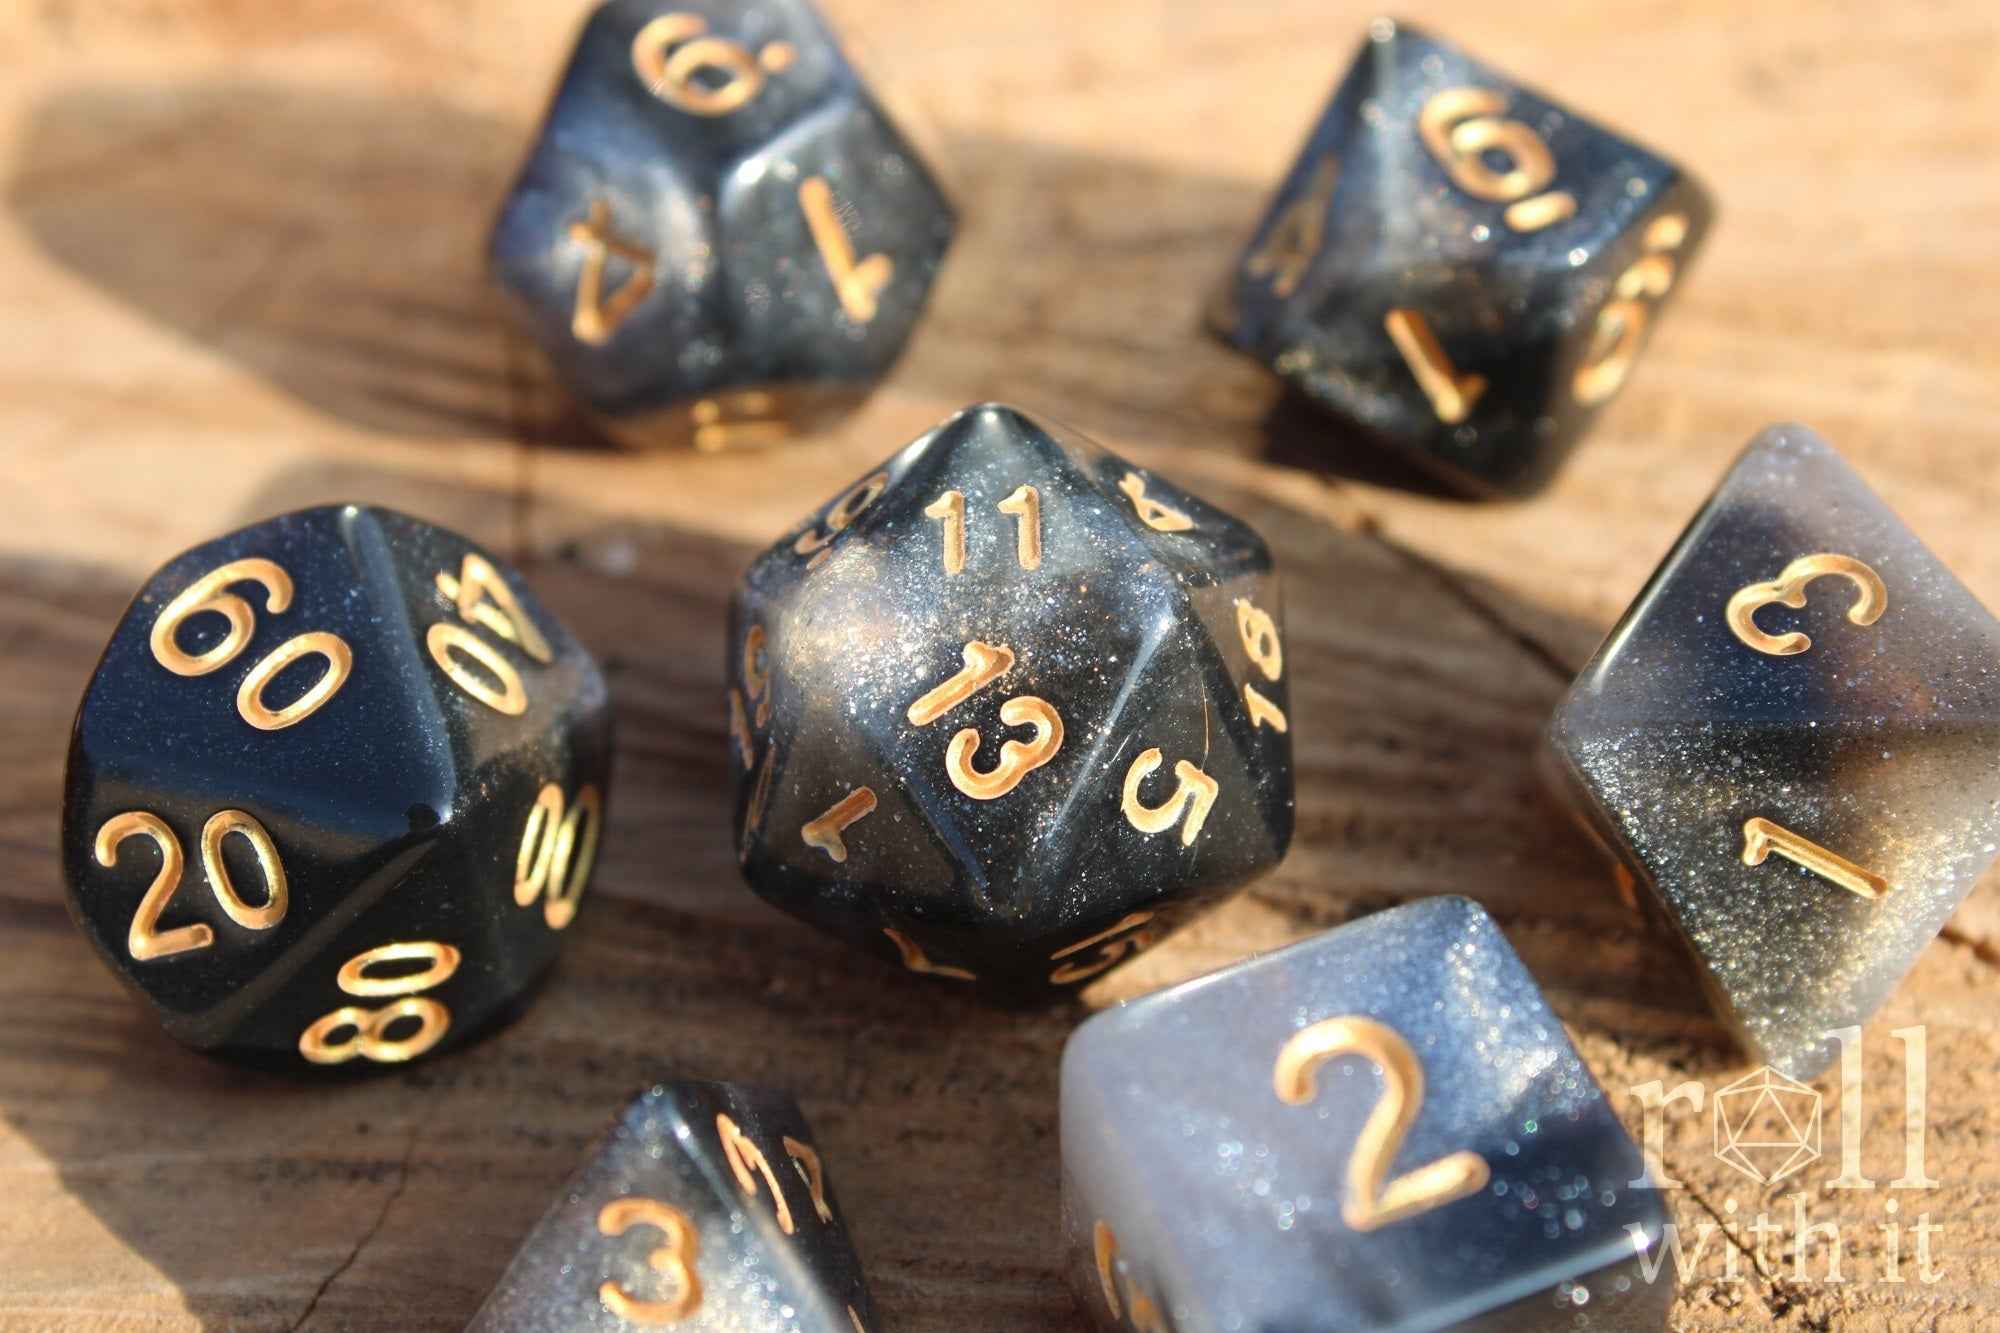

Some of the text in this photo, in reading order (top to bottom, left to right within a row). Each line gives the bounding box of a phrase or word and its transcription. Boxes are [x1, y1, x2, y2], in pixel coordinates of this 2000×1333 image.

[568, 195, 659, 346] 4
[800, 175, 893, 323] 1
[924, 484, 1042, 574] 11
[1117, 471, 1195, 532] 4
[149, 557, 354, 732] 60
[427, 552, 553, 717] 40
[1236, 598, 1289, 734] 18
[1726, 552, 1889, 657] 3
[907, 640, 1065, 800] 13
[801, 785, 877, 864] 1
[1122, 746, 1220, 848] 5
[1741, 816, 1889, 899] 1
[94, 809, 290, 962] 20
[299, 940, 460, 1065] 80
[1273, 1014, 1491, 1232] 2
[599, 1197, 703, 1326] 3
